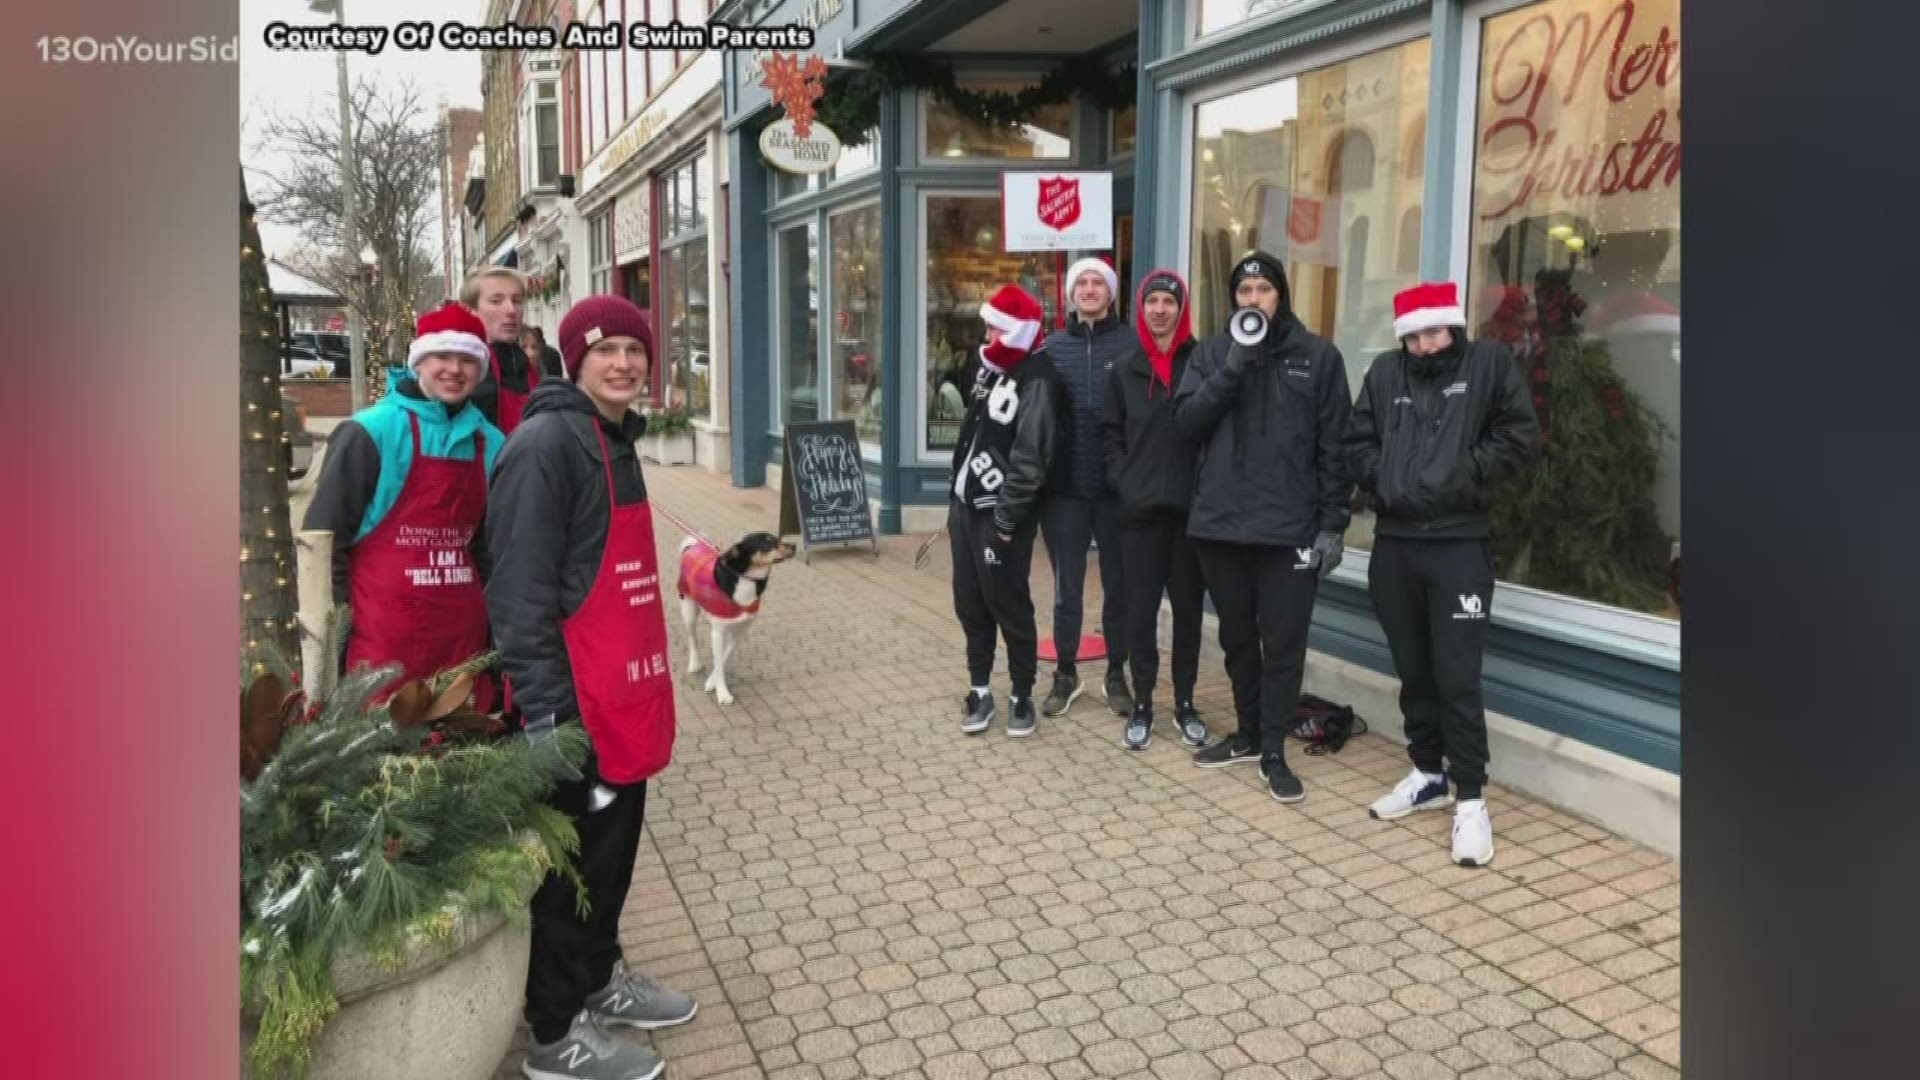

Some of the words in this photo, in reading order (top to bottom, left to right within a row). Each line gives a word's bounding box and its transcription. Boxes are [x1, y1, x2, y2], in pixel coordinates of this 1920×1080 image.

[769, 138, 830, 151] SEASONED
[794, 150, 829, 162] HOME
[400, 526, 440, 537] DOING
[396, 537, 428, 547] MOST
[437, 551, 456, 566] AM
